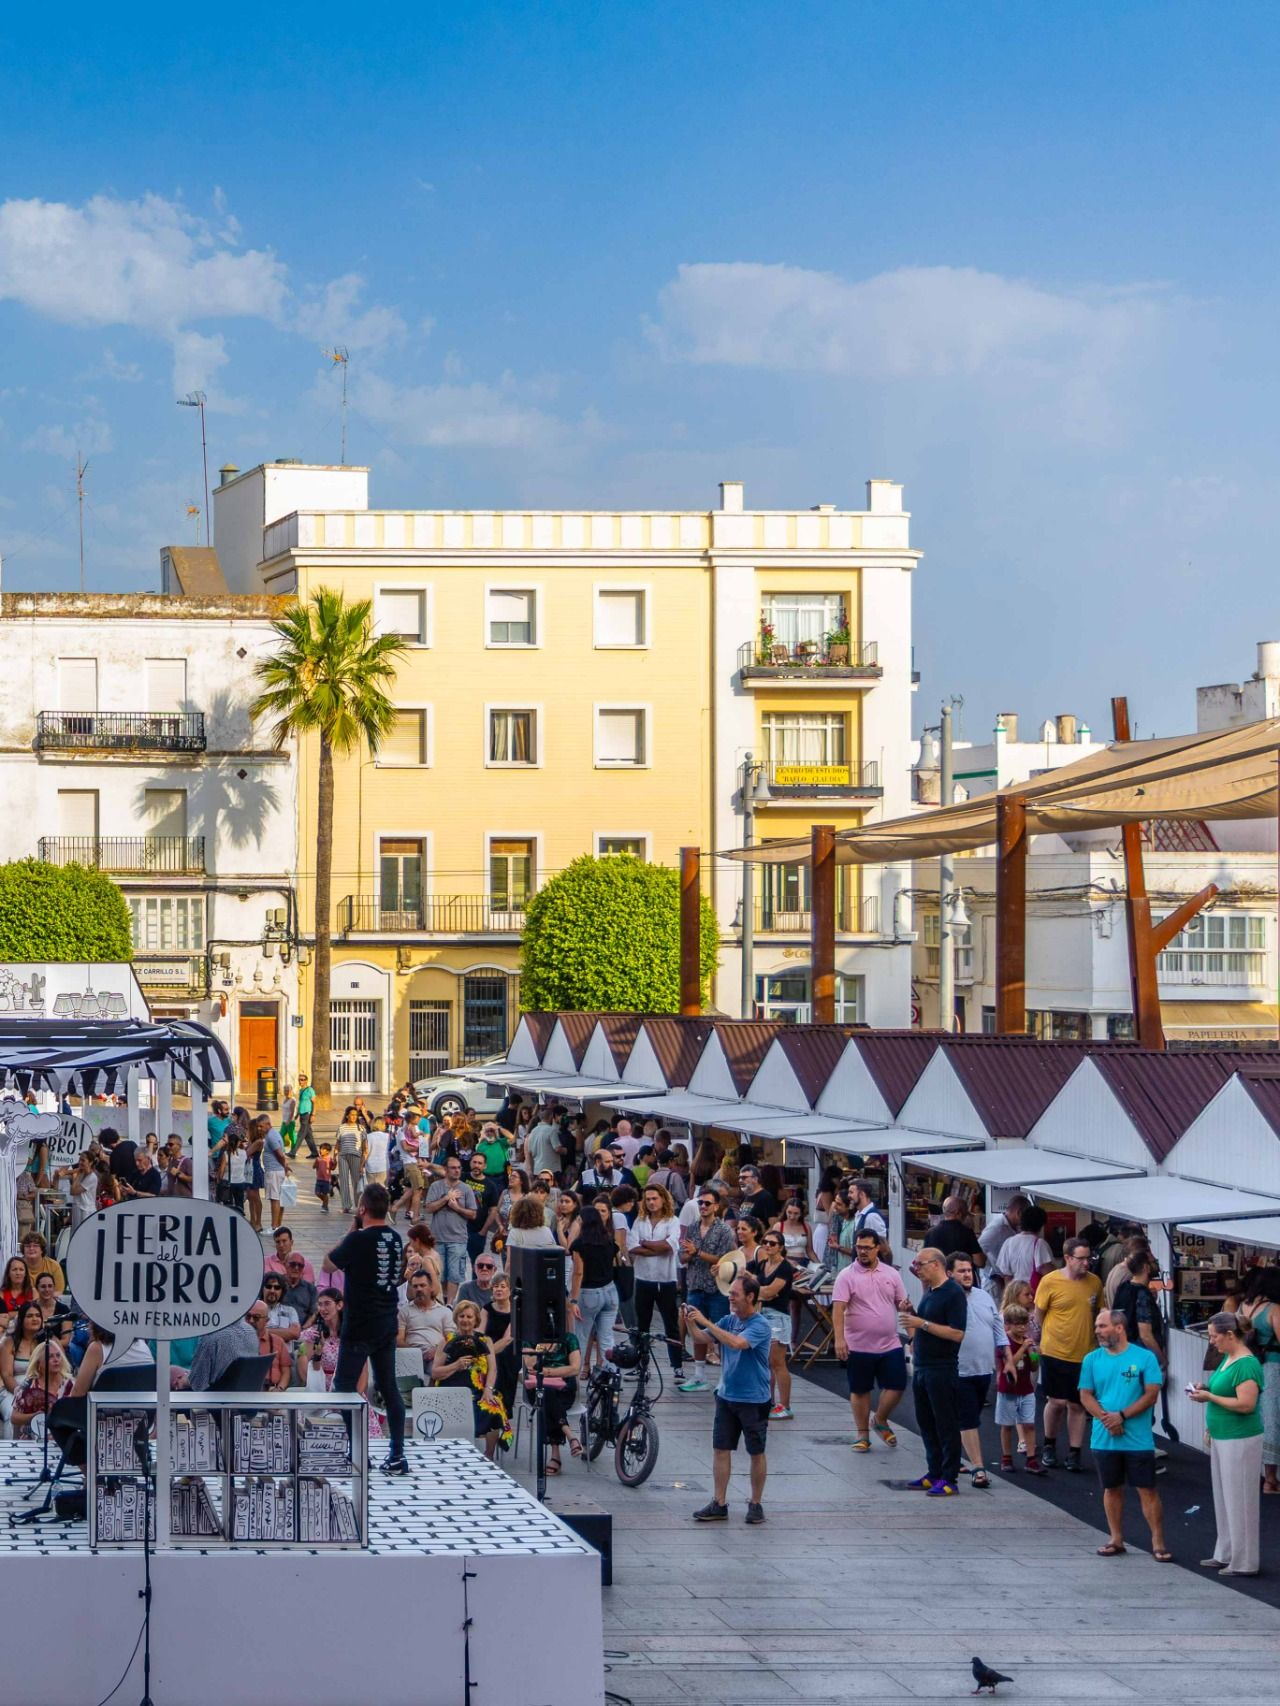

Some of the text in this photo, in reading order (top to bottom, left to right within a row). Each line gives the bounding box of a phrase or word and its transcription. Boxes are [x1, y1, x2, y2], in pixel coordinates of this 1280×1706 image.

[157, 1244, 183, 1262] del
[113, 1310, 220, 1327] SAN FERNANDO
